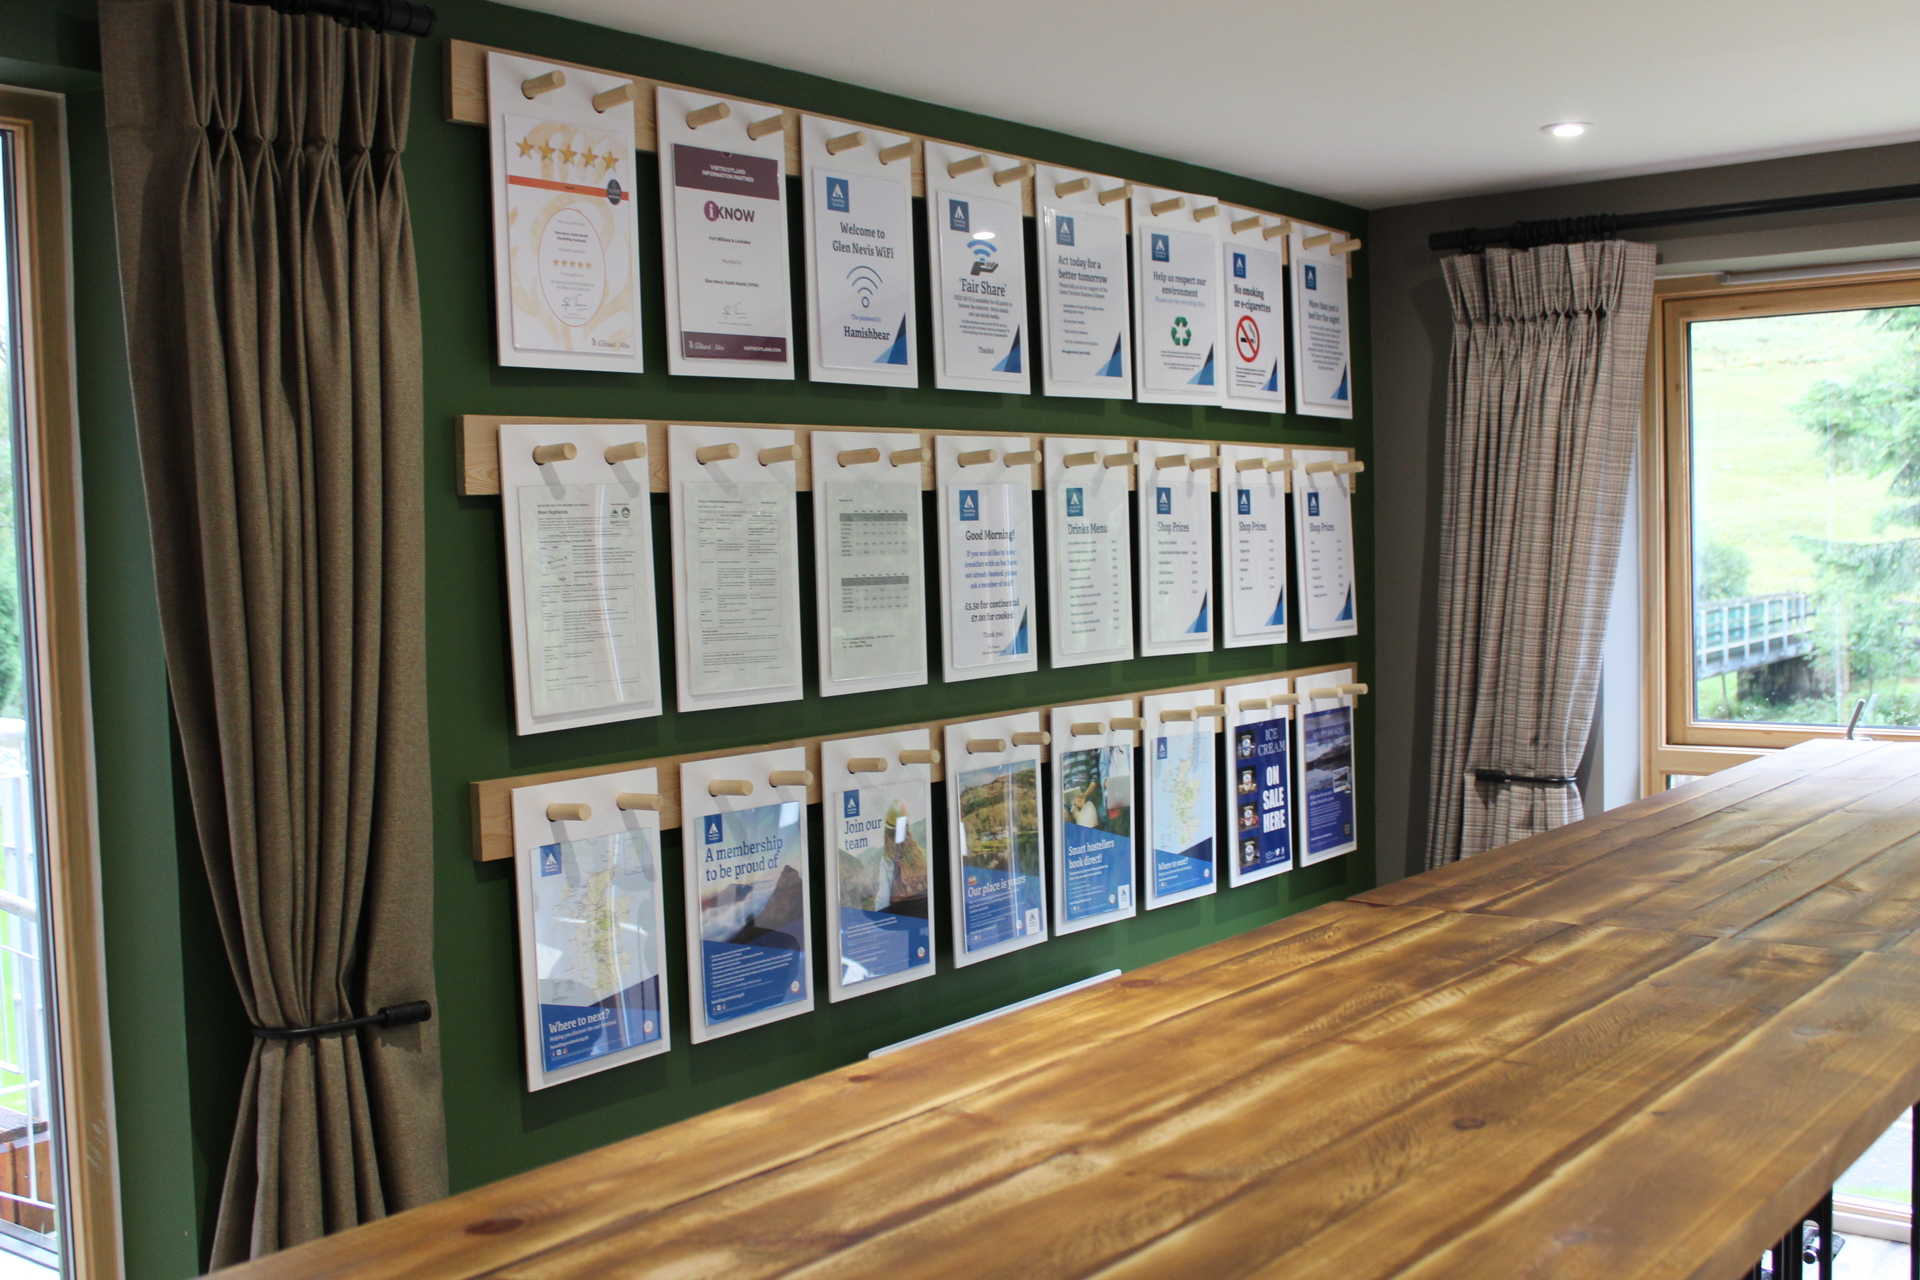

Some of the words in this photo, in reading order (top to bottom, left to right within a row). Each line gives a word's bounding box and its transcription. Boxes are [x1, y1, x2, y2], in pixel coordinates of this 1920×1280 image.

[702, 169, 733, 179] INFORMATION
[733, 174, 754, 183] PARTNER
[710, 164, 746, 175] VISITSCOTLAND
[840, 221, 876, 238] Welcome
[877, 228, 885, 239] to
[832, 240, 851, 253] Glen
[852, 242, 875, 256] Nevis
[875, 245, 894, 259] WiFi
[1058, 255, 1069, 265] Act
[1070, 257, 1087, 270] today
[1087, 257, 1097, 269] for
[1097, 261, 1102, 269] a
[1058, 268, 1077, 280] better
[1078, 272, 1108, 283] tomorrow
[1153, 270, 1167, 284] Help
[1175, 276, 1196, 286] respect
[1196, 278, 1206, 286] our
[1161, 285, 1198, 297] environment
[1234, 283, 1241, 294] No
[1242, 286, 1264, 301] smoking
[1234, 299, 1241, 308] or
[1241, 299, 1271, 313] e-cigarettes
[1308, 299, 1319, 309] More
[1319, 301, 1328, 310] than
[1328, 303, 1336, 313] just
[1308, 310, 1316, 320] bed
[1329, 315, 1340, 325] night!
[843, 325, 890, 340] Hamishbear
[978, 346, 995, 354] Thanks!
[965, 529, 984, 541] Good
[984, 528, 1015, 542] Morning!
[1067, 523, 1089, 535] Drinks
[1090, 523, 1108, 534] Menu
[1157, 521, 1172, 534] Shop
[1172, 521, 1189, 532] Prices
[1238, 521, 1252, 534] Shop
[1252, 521, 1267, 531] Prices
[1309, 522, 1321, 534] Shop
[1321, 522, 1335, 532] Prices
[966, 550, 971, 558] If
[979, 549, 992, 557] would
[965, 602, 980, 611] £5.50
[980, 600, 989, 609] for
[971, 614, 986, 623] £7.00
[986, 612, 995, 621] for
[983, 630, 995, 638] Thank
[1265, 728, 1279, 741] ICE
[1257, 740, 1286, 756] CREAM
[1266, 765, 1280, 786] ON
[1262, 787, 1285, 811] SALE
[844, 819, 864, 834] Join
[866, 818, 882, 830] our
[1263, 809, 1286, 833] HERE
[705, 848, 714, 862] A
[716, 835, 783, 861] membership
[845, 837, 868, 850] team
[1068, 845, 1087, 856] Smart
[1087, 838, 1115, 852] hostellers
[705, 868, 717, 881] to
[719, 864, 732, 879] be
[735, 856, 765, 879] proud
[768, 853, 779, 869] of
[1068, 857, 1084, 869] book
[1083, 852, 1103, 866] direct!
[1158, 862, 1172, 870] Where
[1172, 860, 1177, 868] to
[1177, 856, 1189, 866] next?
[967, 886, 981, 898] Our
[982, 882, 1000, 897] place
[1001, 878, 1007, 889] is
[548, 1018, 577, 1034] Where
[577, 1016, 587, 1026] to
[587, 1008, 611, 1024] next?
